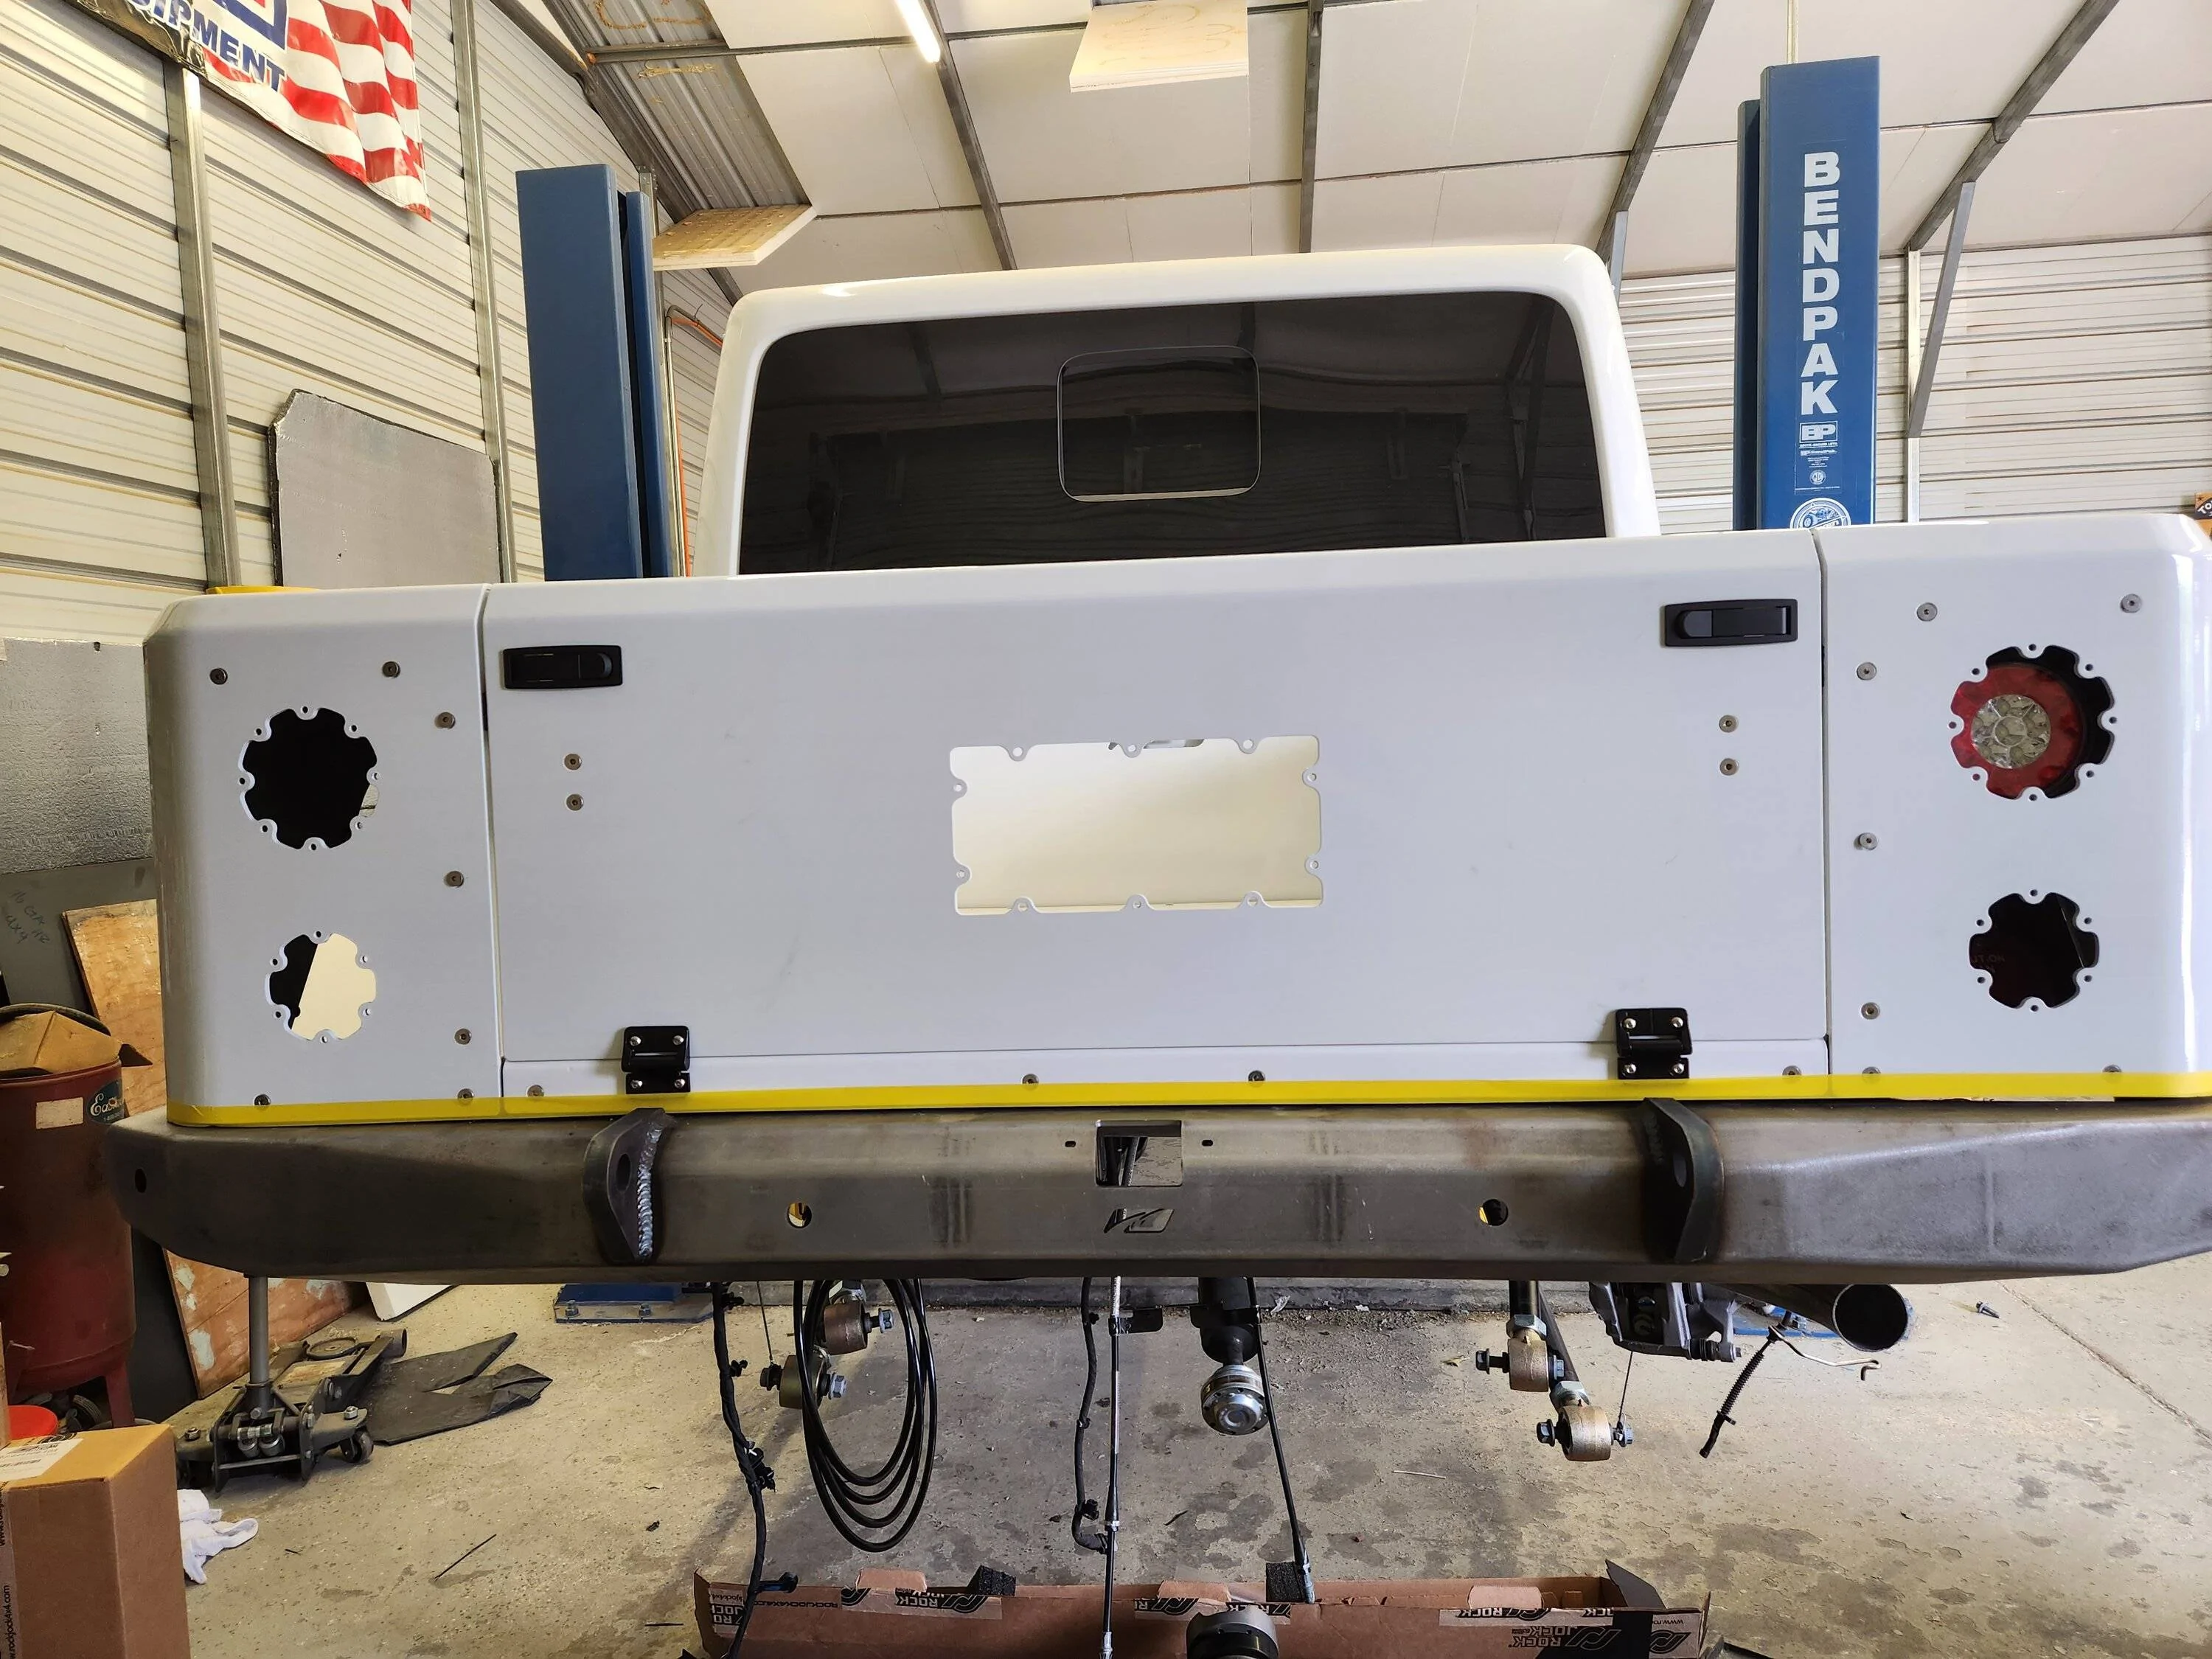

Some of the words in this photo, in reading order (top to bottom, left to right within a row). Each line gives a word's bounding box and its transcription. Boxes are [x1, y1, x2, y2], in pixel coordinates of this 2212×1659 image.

[131, 0, 285, 92] IPMENT
[1801, 151, 1840, 415] BENDPAK
[1801, 424, 1836, 440] BP
[900, 1596, 938, 1607] ROCK
